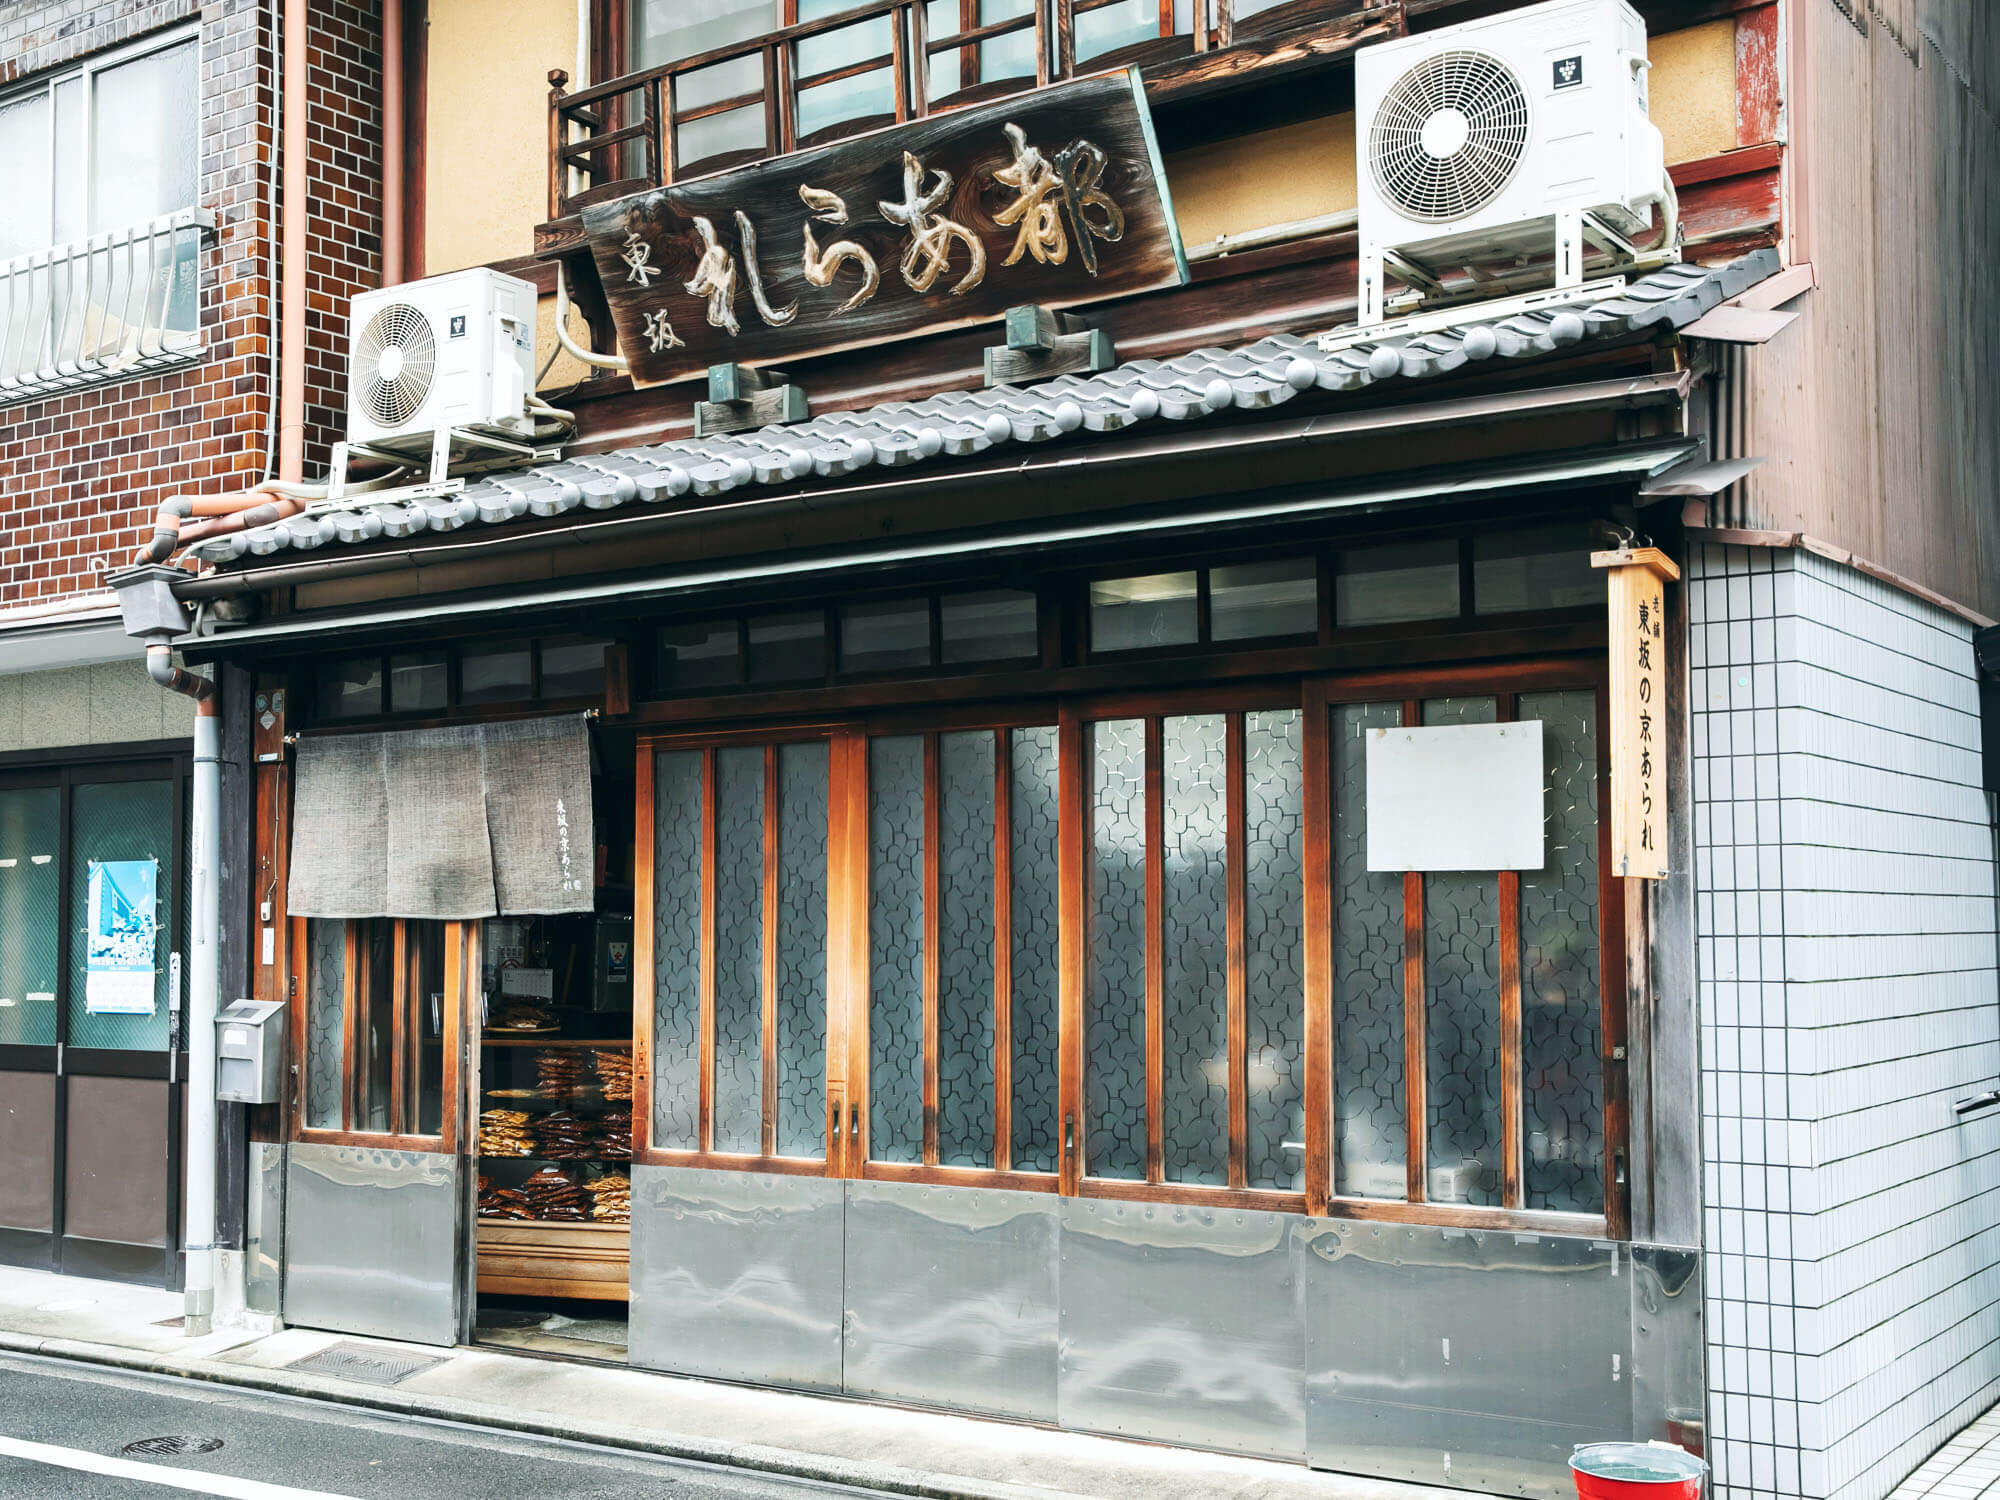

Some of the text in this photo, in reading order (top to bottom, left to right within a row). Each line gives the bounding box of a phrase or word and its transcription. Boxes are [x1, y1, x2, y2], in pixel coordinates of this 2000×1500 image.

[620, 226, 686, 355] 東坂
[1637, 599, 1655, 852] 東坂の京あられ
[556, 798, 574, 891] 東坂の京あられ
